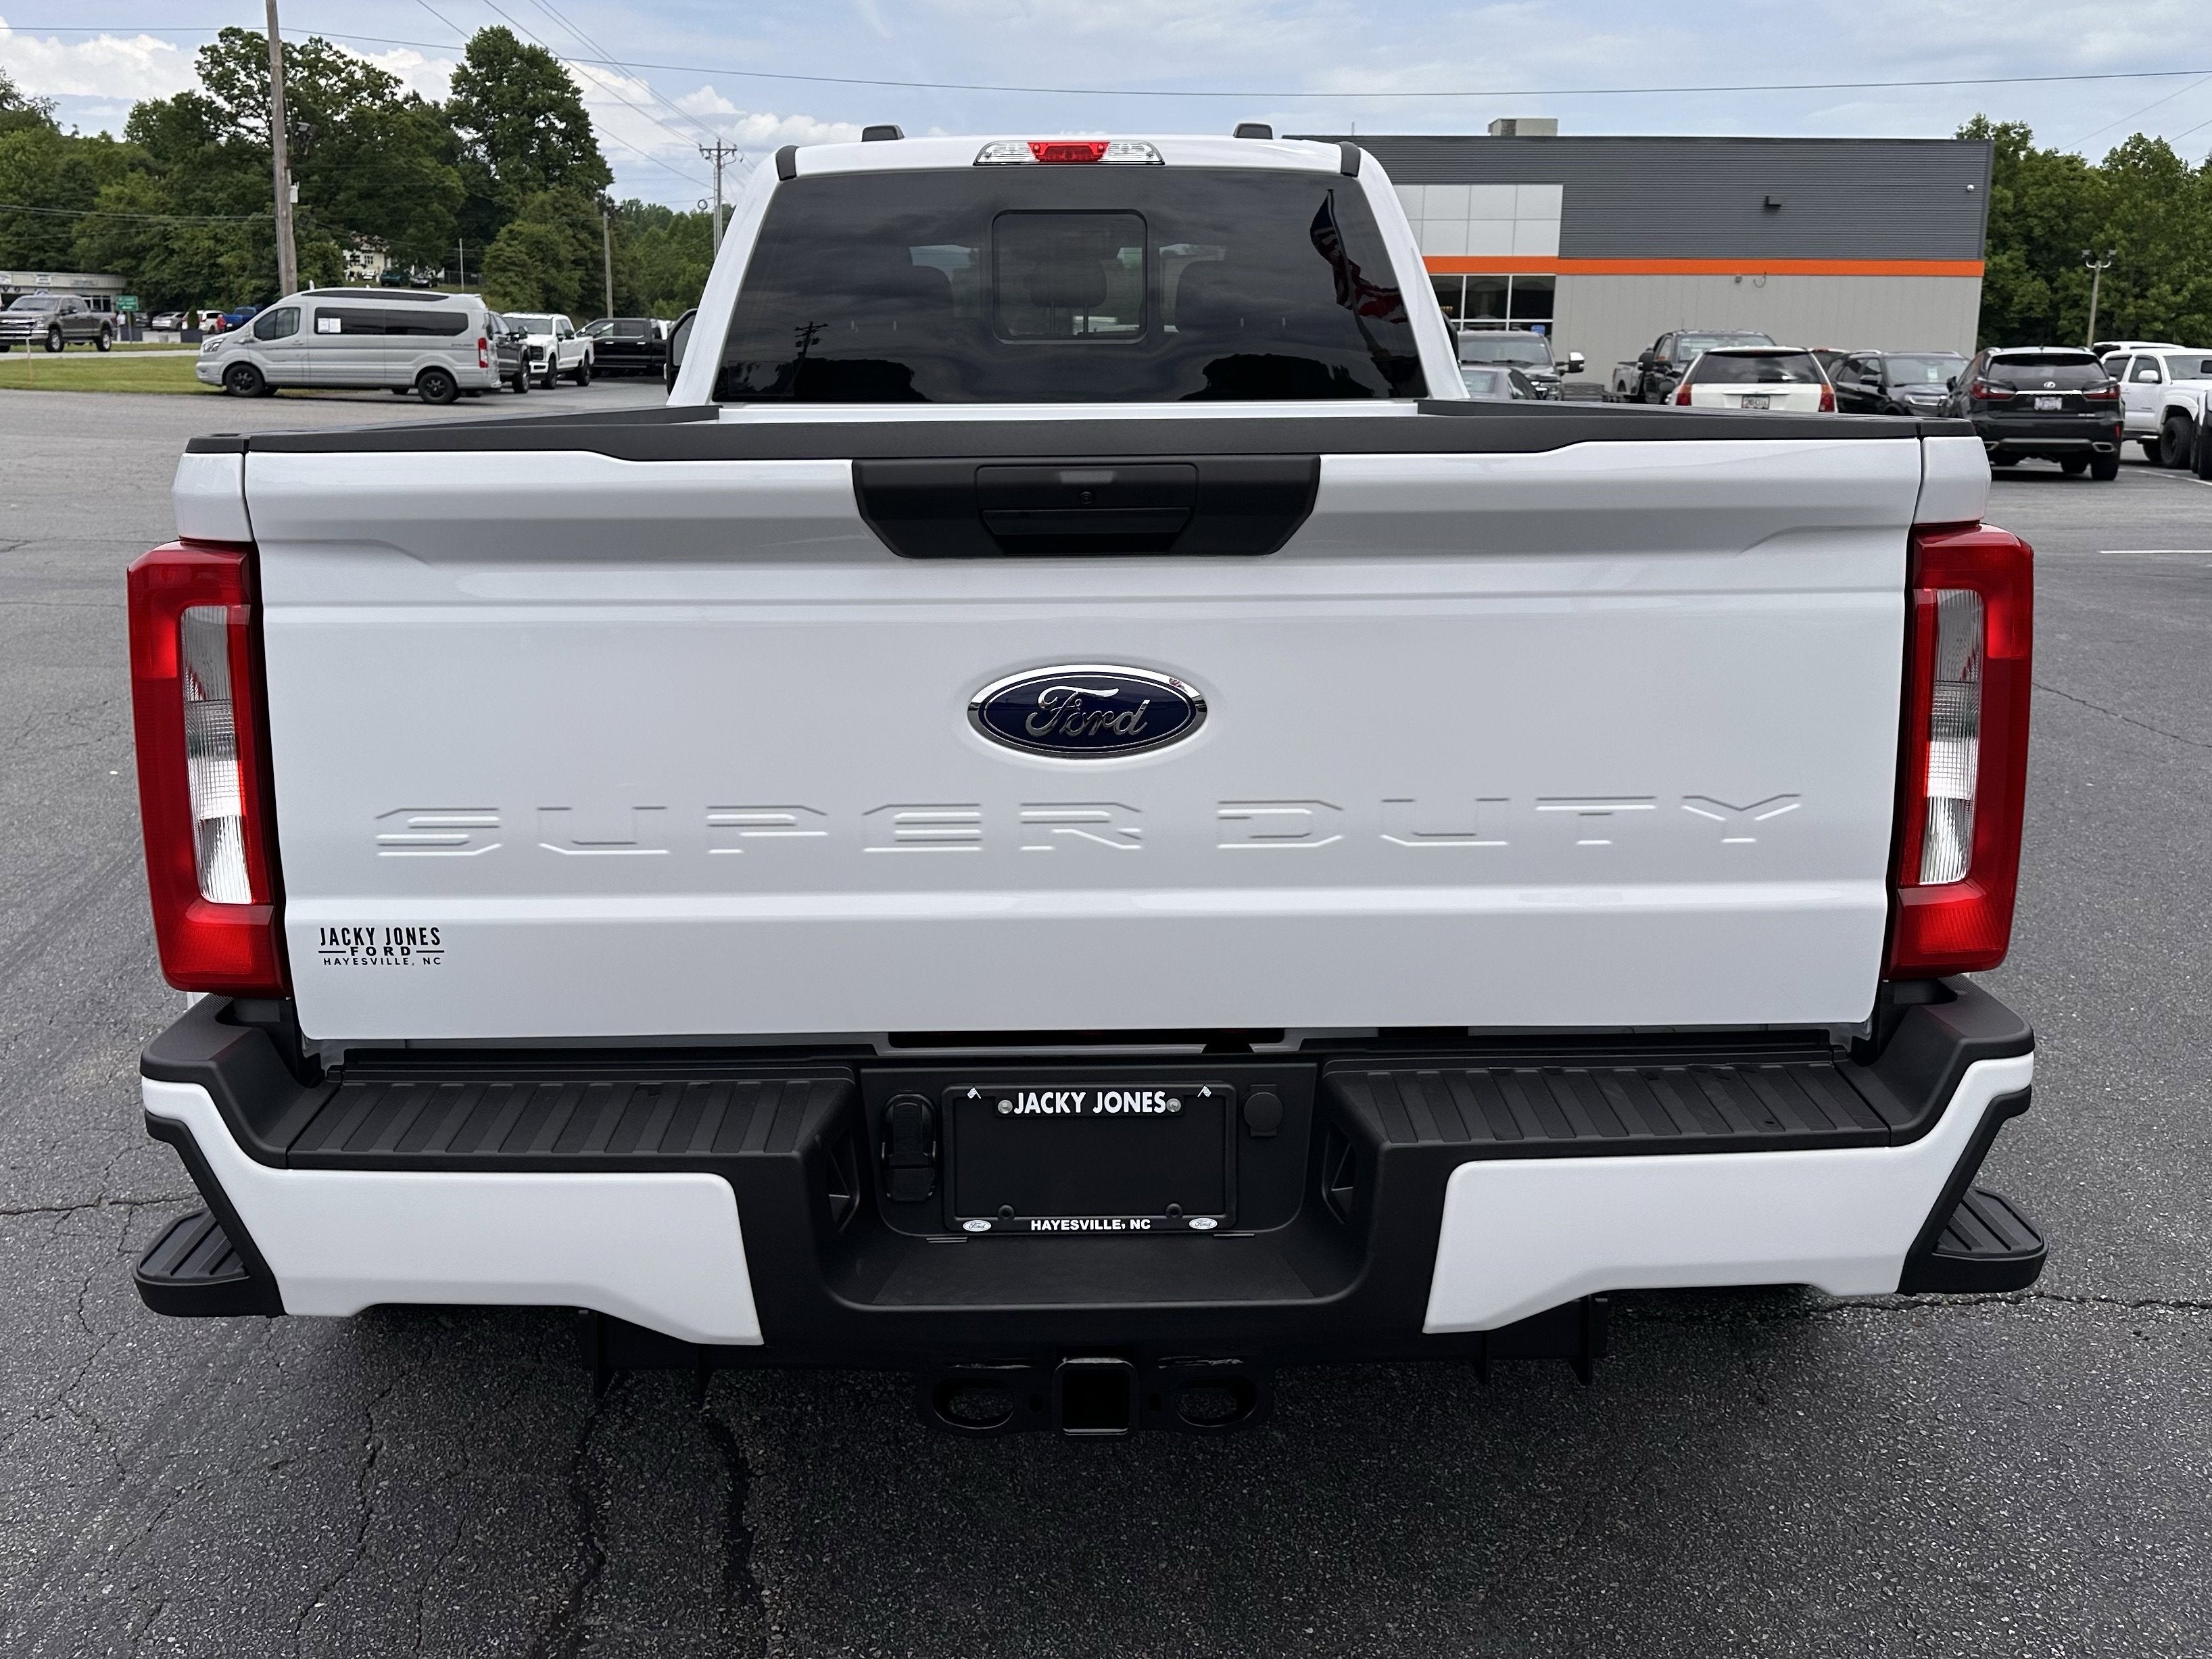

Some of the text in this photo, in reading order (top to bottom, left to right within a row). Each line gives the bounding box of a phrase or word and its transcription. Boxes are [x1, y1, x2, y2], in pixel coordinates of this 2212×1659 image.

[1024, 685, 1151, 738] Ford
[375, 793, 1802, 857] SUPER DUTY
[320, 927, 441, 946] JACKY JONES
[350, 946, 411, 957] FORD
[323, 957, 441, 967] HAYESVILLE, NC
[1013, 1090, 1166, 1114] JACKY JONES
[1030, 1218, 1151, 1231] HAYESVILLE, NC
